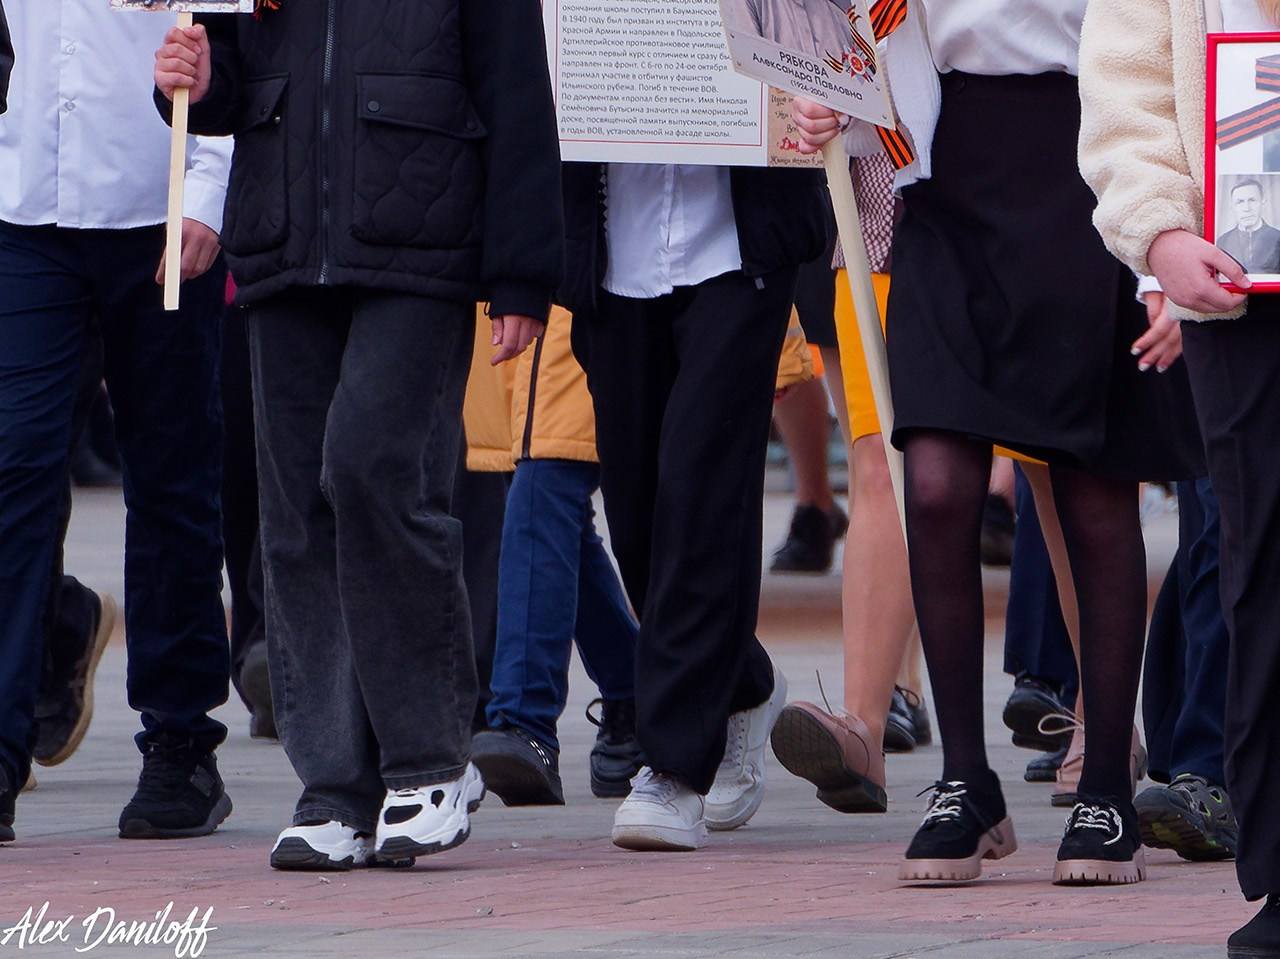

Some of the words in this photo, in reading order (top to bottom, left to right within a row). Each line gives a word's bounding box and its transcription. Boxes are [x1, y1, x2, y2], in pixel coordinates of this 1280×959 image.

[562, 4, 602, 12] окончания
[631, 7, 665, 15] поступил
[672, 7, 718, 15] Бауманское
[570, 15, 587, 23] 1940
[606, 16, 622, 24] был
[666, 19, 703, 27] института
[562, 26, 593, 35] Красной
[595, 27, 621, 36] Армии
[629, 29, 669, 37] направлен
[677, 29, 721, 38] Подольское
[562, 37, 624, 46] Артиллерийское
[626, 40, 690, 49] противотанковое
[692, 42, 727, 50] училище.
[562, 48, 597, 56] Закончил
[599, 50, 627, 58] первый
[719, 52, 731, 60] бы
[562, 61, 602, 69] направлен
[614, 61, 639, 70] фронт.
[647, 61, 662, 69] 6-го
[675, 62, 696, 70] 24-ое
[697, 63, 728, 72] октября
[779, 51, 829, 78] РЯБКОВА
[602, 73, 630, 81] участие
[638, 72, 668, 80] отбитии
[676, 74, 713, 82] фашистов
[752, 53, 813, 84] Александра
[814, 76, 863, 101] Павловна
[561, 82, 605, 90] Ильинского
[607, 83, 636, 92] рубежа.
[639, 83, 661, 91] Погиб
[701, 85, 719, 93] ВОВ.
[573, 94, 619, 102] документам
[561, 103, 607, 111] Семёновича
[609, 105, 645, 113] Бутысина
[691, 108, 748, 116] мемориальной
[560, 116, 584, 124] доске,
[586, 116, 637, 124] посвященной
[587, 127, 604, 135] ВОВ,
[606, 128, 663, 136] установленной
[675, 129, 703, 137] фасаде
